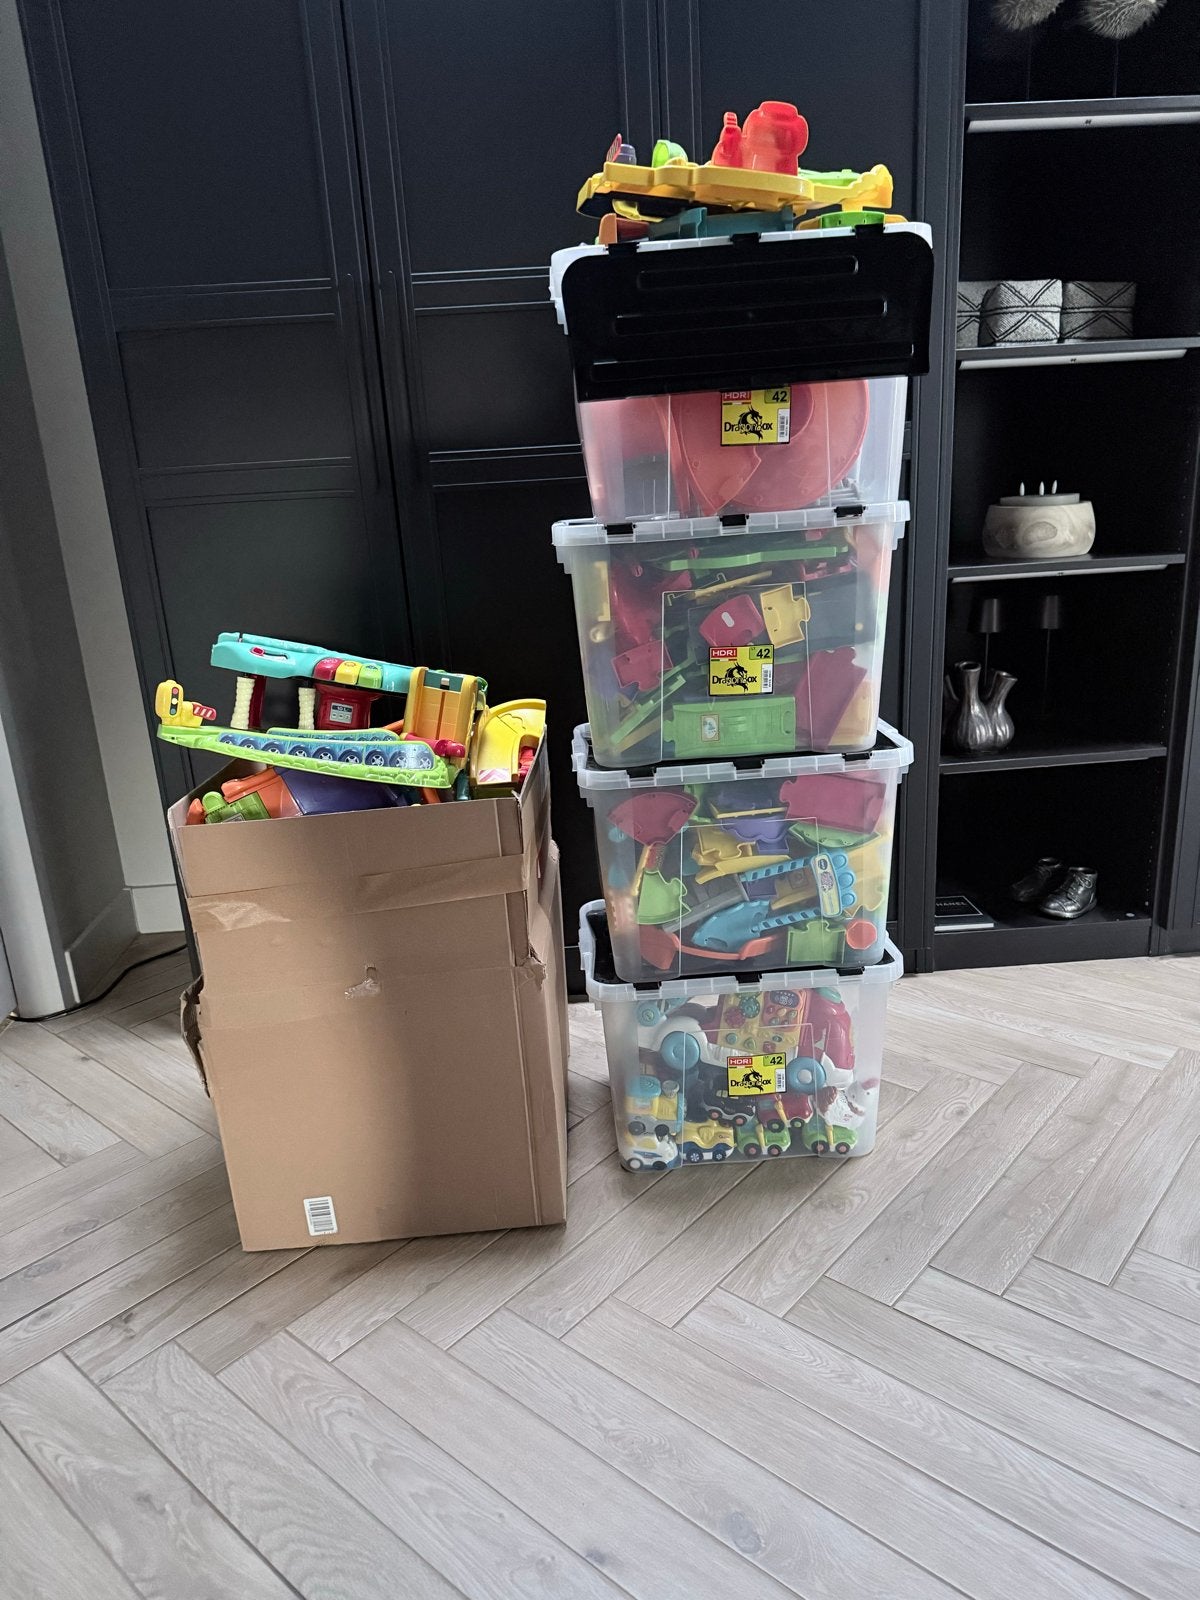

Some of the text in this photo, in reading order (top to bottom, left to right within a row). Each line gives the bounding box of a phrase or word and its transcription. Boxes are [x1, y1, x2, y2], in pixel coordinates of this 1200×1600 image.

[772, 391, 788, 402] 42
[756, 648, 770, 659] 42
[769, 1055, 783, 1065] 42
